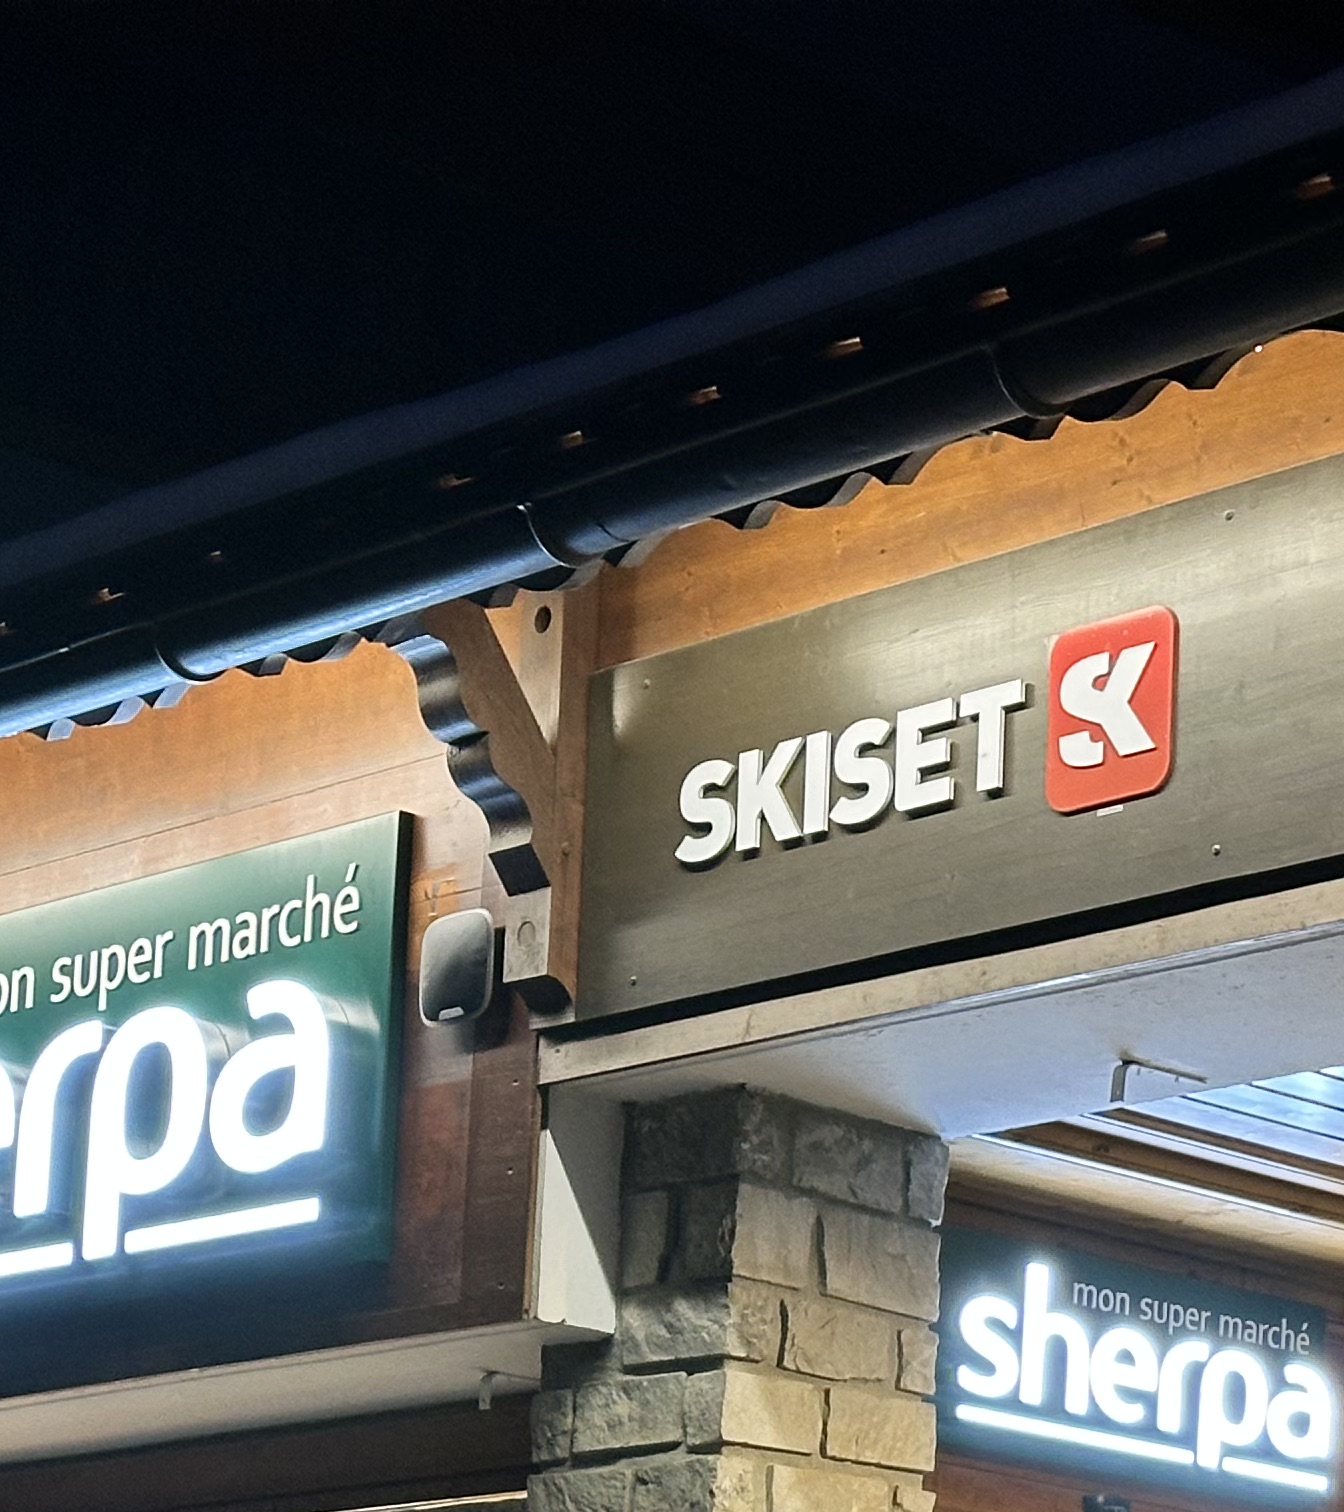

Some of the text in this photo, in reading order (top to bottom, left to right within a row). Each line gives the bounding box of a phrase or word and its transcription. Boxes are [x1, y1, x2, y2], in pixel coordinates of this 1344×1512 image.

[673, 678, 1030, 866] SKISET
[51, 929, 175, 1012] super
[187, 862, 361, 973] marché
[956, 1261, 1335, 1470] sherpa
[1072, 1280, 1310, 1355] mon super marché
